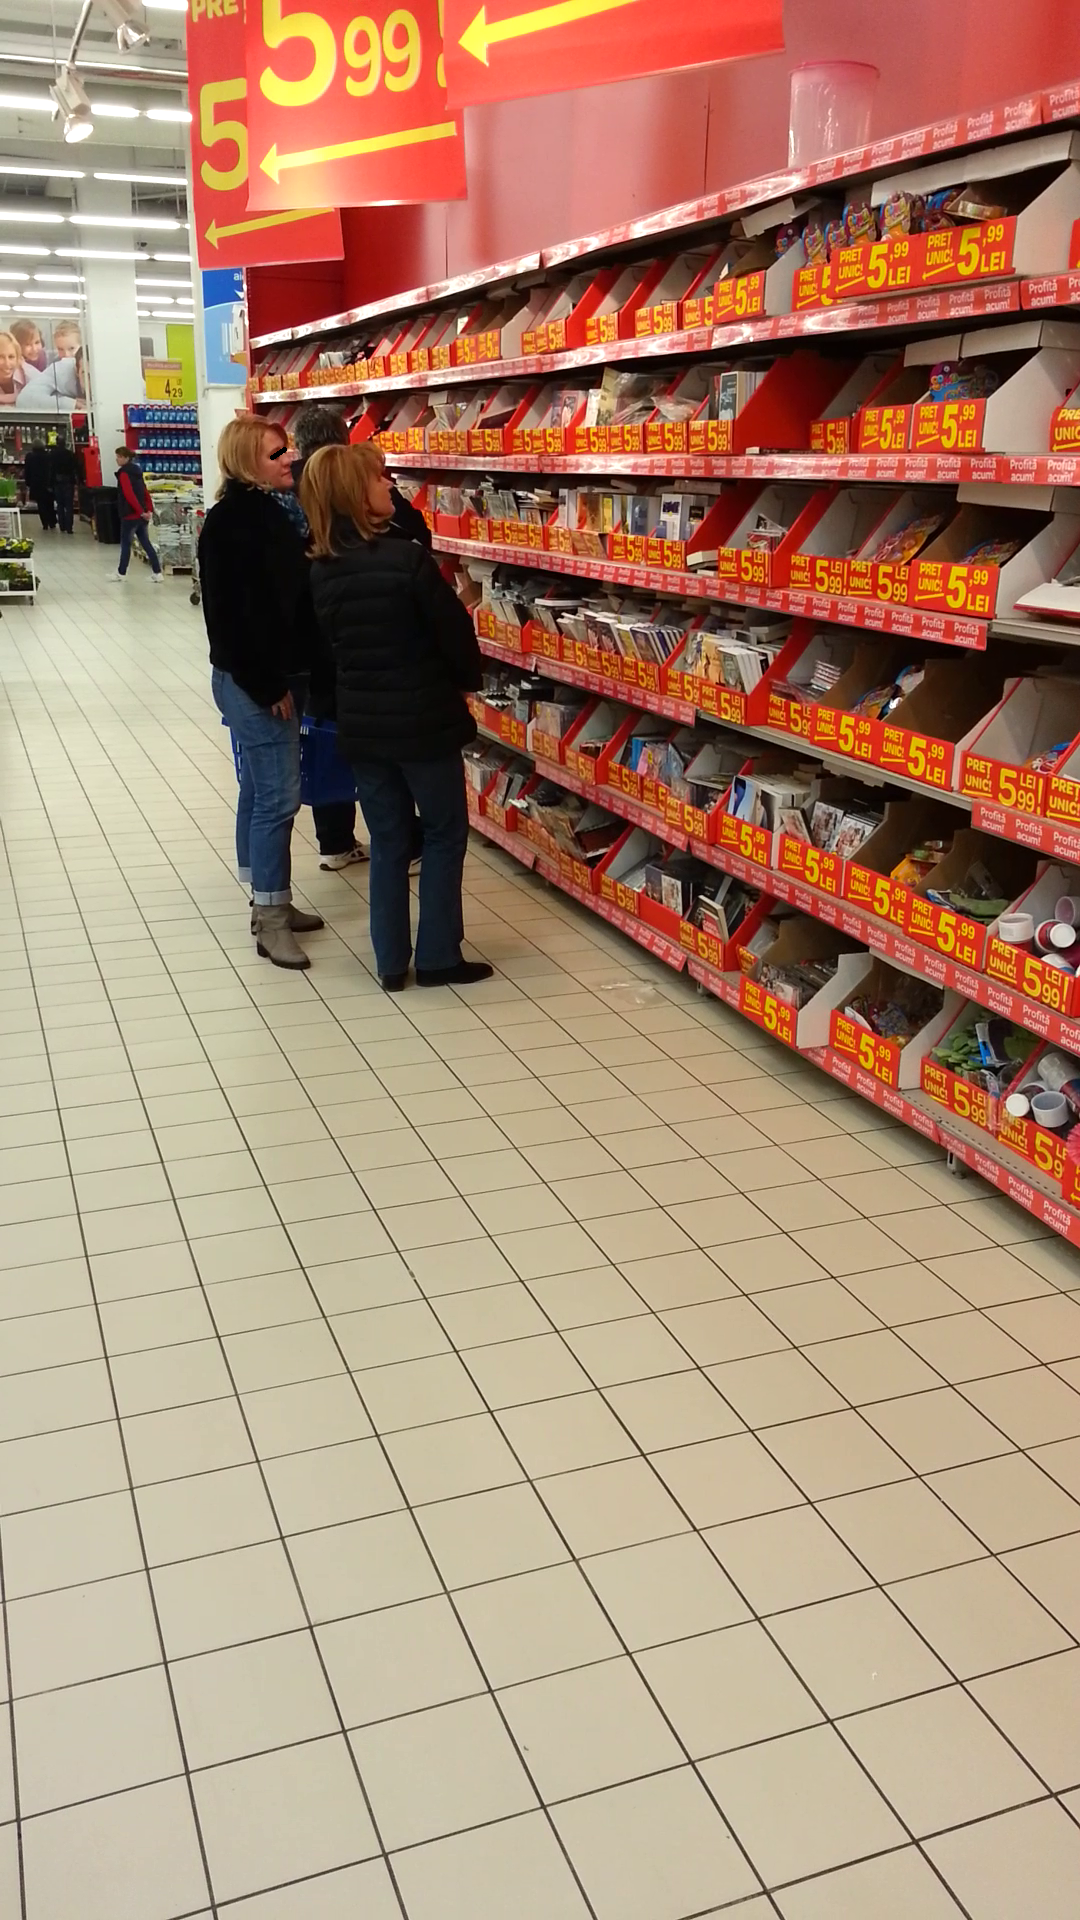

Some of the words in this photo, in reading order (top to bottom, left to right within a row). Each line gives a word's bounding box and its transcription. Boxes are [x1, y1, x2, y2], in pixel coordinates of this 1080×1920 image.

[190, 0, 247, 23] PRE
[259, 0, 337, 107] 5
[199, 78, 248, 191] 5
[980, 251, 1005, 273] LEI
[888, 265, 910, 286] LEI
[985, 296, 1010, 312] acum!
[1030, 292, 1056, 307] acum!
[950, 303, 974, 316] acum!
[958, 430, 976, 448] LEI
[971, 469, 995, 481] acum!
[1011, 470, 1034, 482] acum!
[1048, 471, 1073, 483] acum!
[741, 551, 753, 581] 5
[815, 560, 828, 593] 5
[876, 565, 893, 600] 5
[966, 594, 989, 613] LEI
[954, 633, 978, 646] acum!
[720, 691, 731, 720] 5
[790, 702, 801, 732] 5
[854, 742, 872, 759] LEI
[925, 770, 945, 785] LEI
[998, 767, 1017, 807] 5
[982, 820, 1005, 833] acum!
[1016, 831, 1040, 846] acum!
[819, 877, 836, 893] LEI
[890, 906, 904, 924] LE
[868, 937, 886, 951] acum!
[895, 952, 915, 966] acum!
[955, 942, 976, 965] LEI
[924, 967, 945, 981] acum!
[1022, 957, 1042, 997] 5
[1046, 967, 1062, 987] LEI
[956, 983, 978, 998] acum!
[988, 1000, 1011, 1016] acum!
[1023, 1018, 1048, 1034] acum!
[874, 1062, 893, 1085] LEI
[954, 1081, 970, 1117] 5
[884, 1102, 903, 1117] acum!
[913, 1121, 933, 1136] acum!
[1034, 1131, 1053, 1171] 5
[1009, 1188, 1032, 1209] acum!
[1043, 1213, 1069, 1235] acum!
